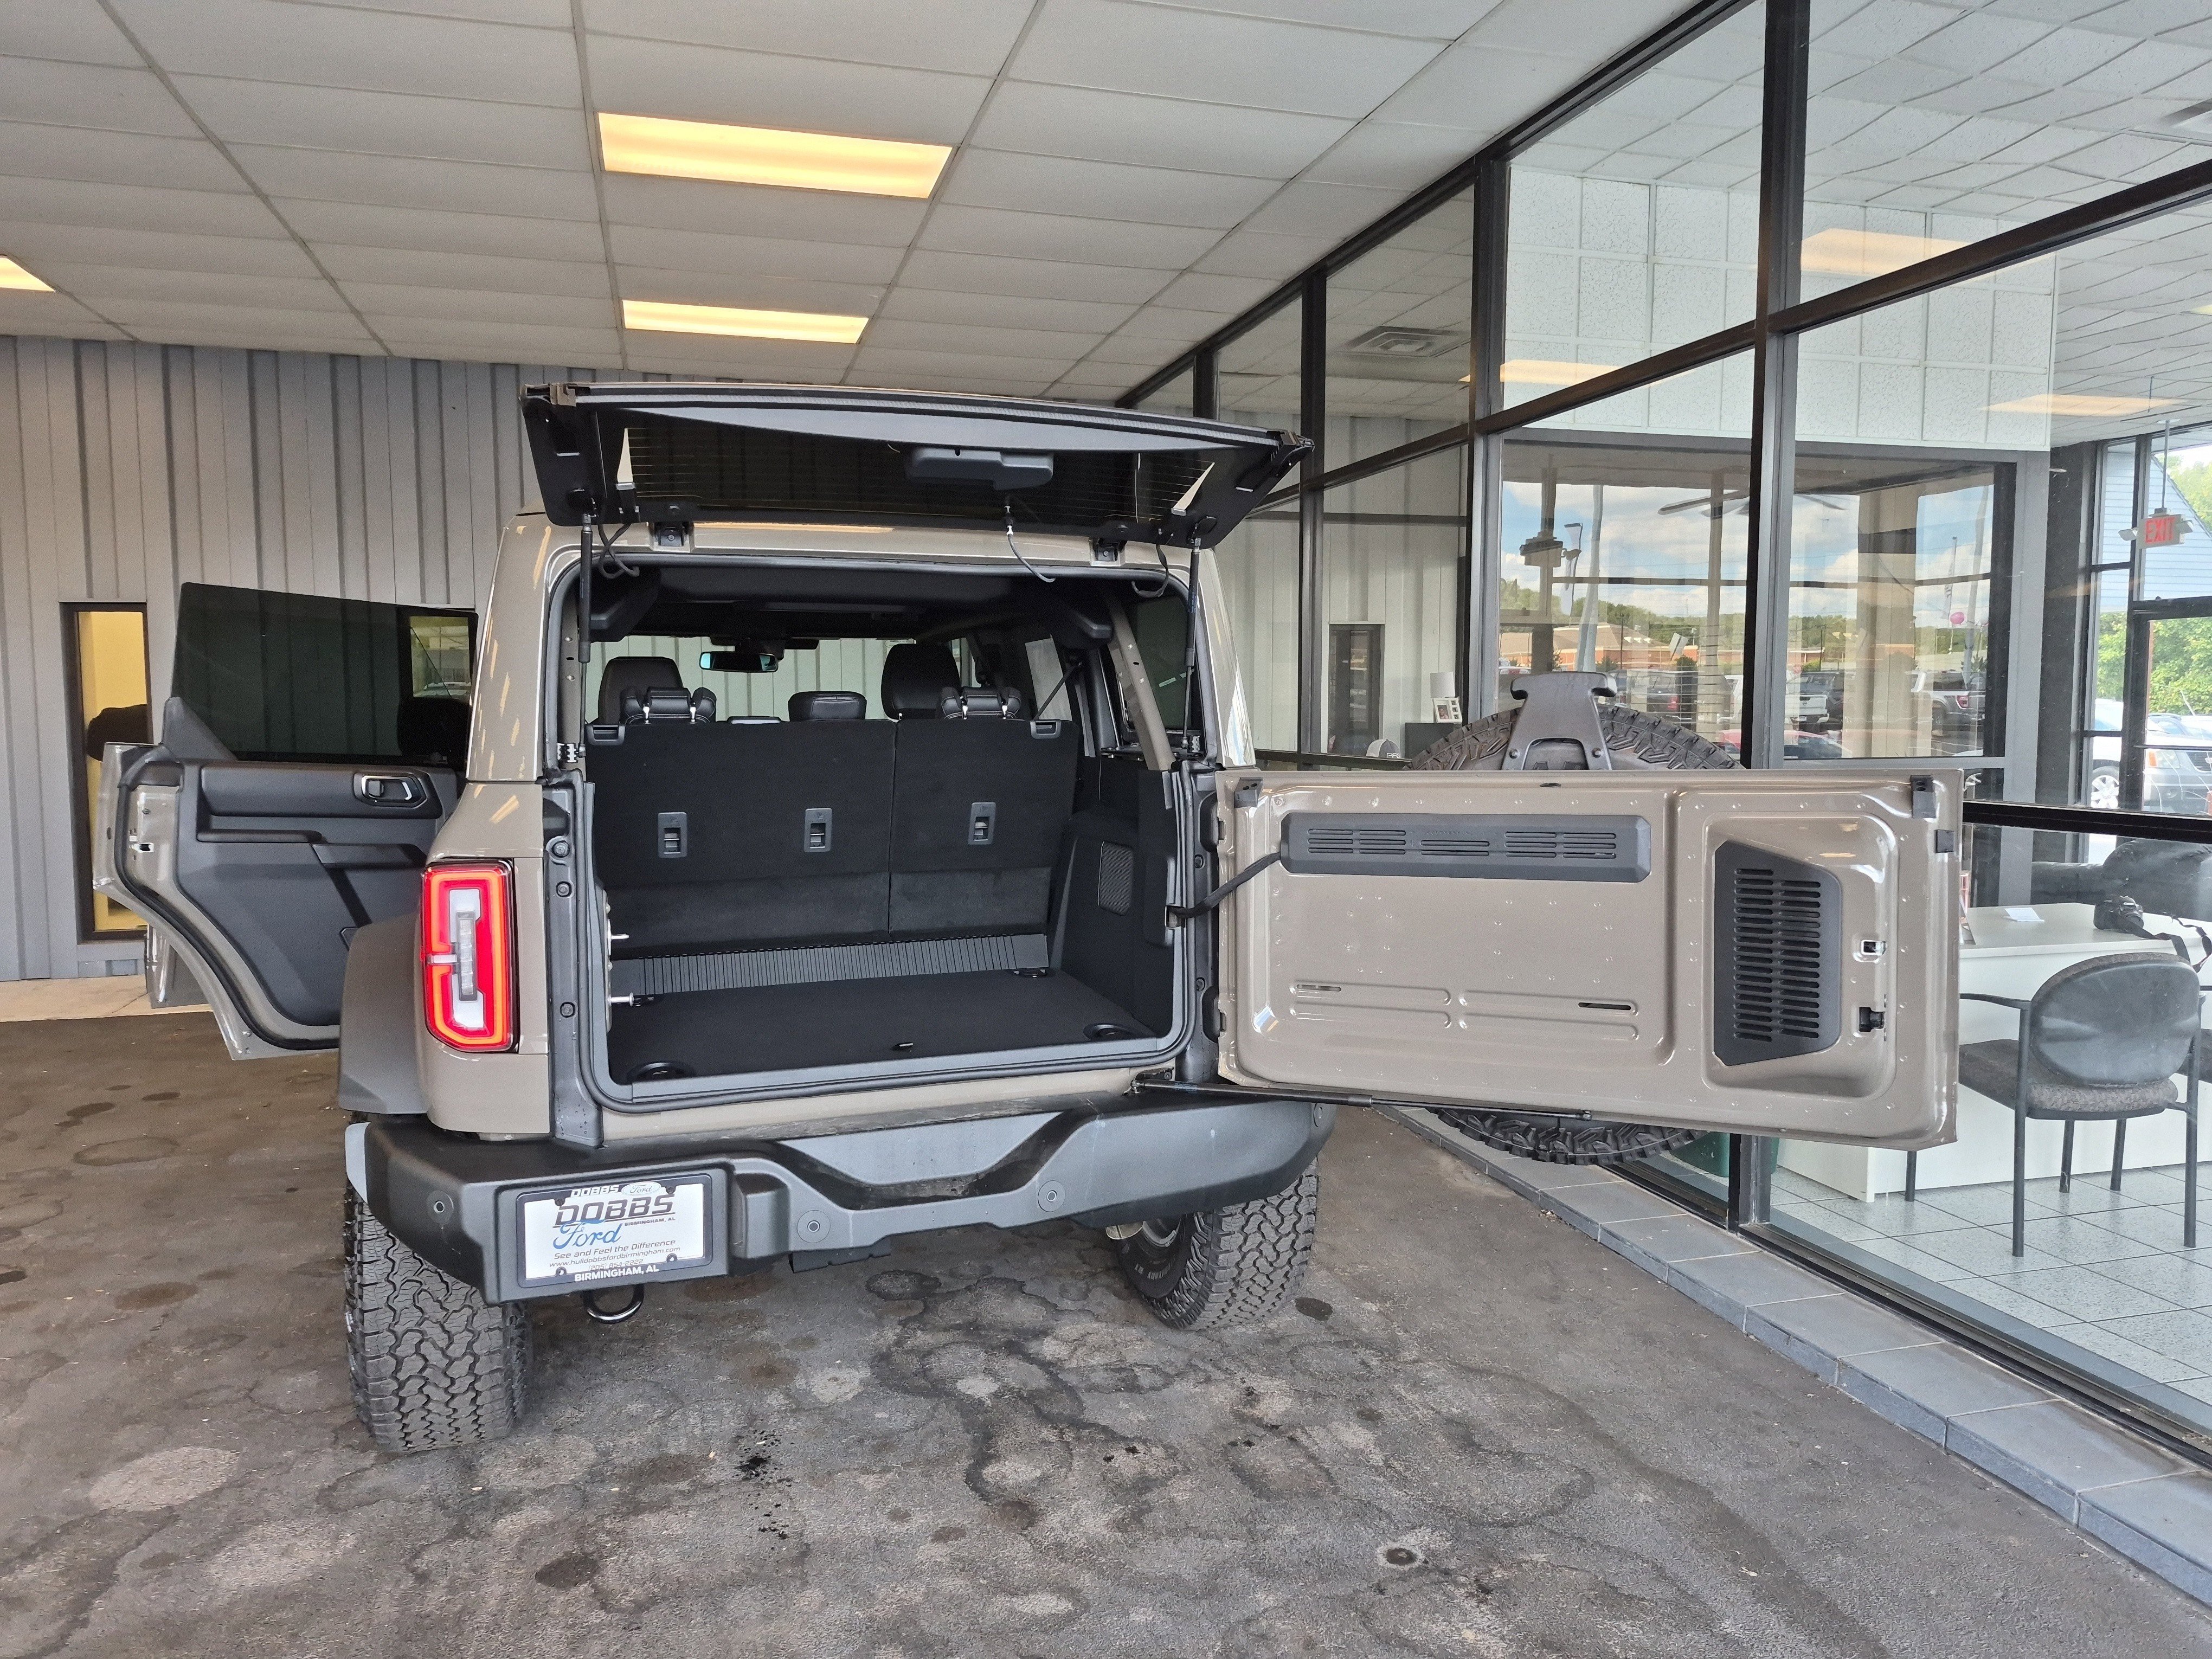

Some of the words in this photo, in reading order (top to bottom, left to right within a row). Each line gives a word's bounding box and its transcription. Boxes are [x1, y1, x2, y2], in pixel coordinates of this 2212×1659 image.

[2145, 516, 2175, 543] EXIT
[570, 1185, 619, 1198] DOBBS
[629, 1184, 653, 1194] Ford
[555, 1193, 675, 1226] DOBBS
[624, 1218, 666, 1226] BIRMINGHAM,
[552, 1218, 622, 1250] Ford
[549, 1247, 680, 1268] www.hulldobbsfordbirmingham.com
[574, 1249, 591, 1257] and
[594, 1246, 613, 1255] Feel
[631, 1240, 676, 1250] Difference
[574, 1266, 644, 1282] BIRMINGHAM,
[645, 1264, 659, 1273] AL
[588, 1263, 607, 1271] (205)
